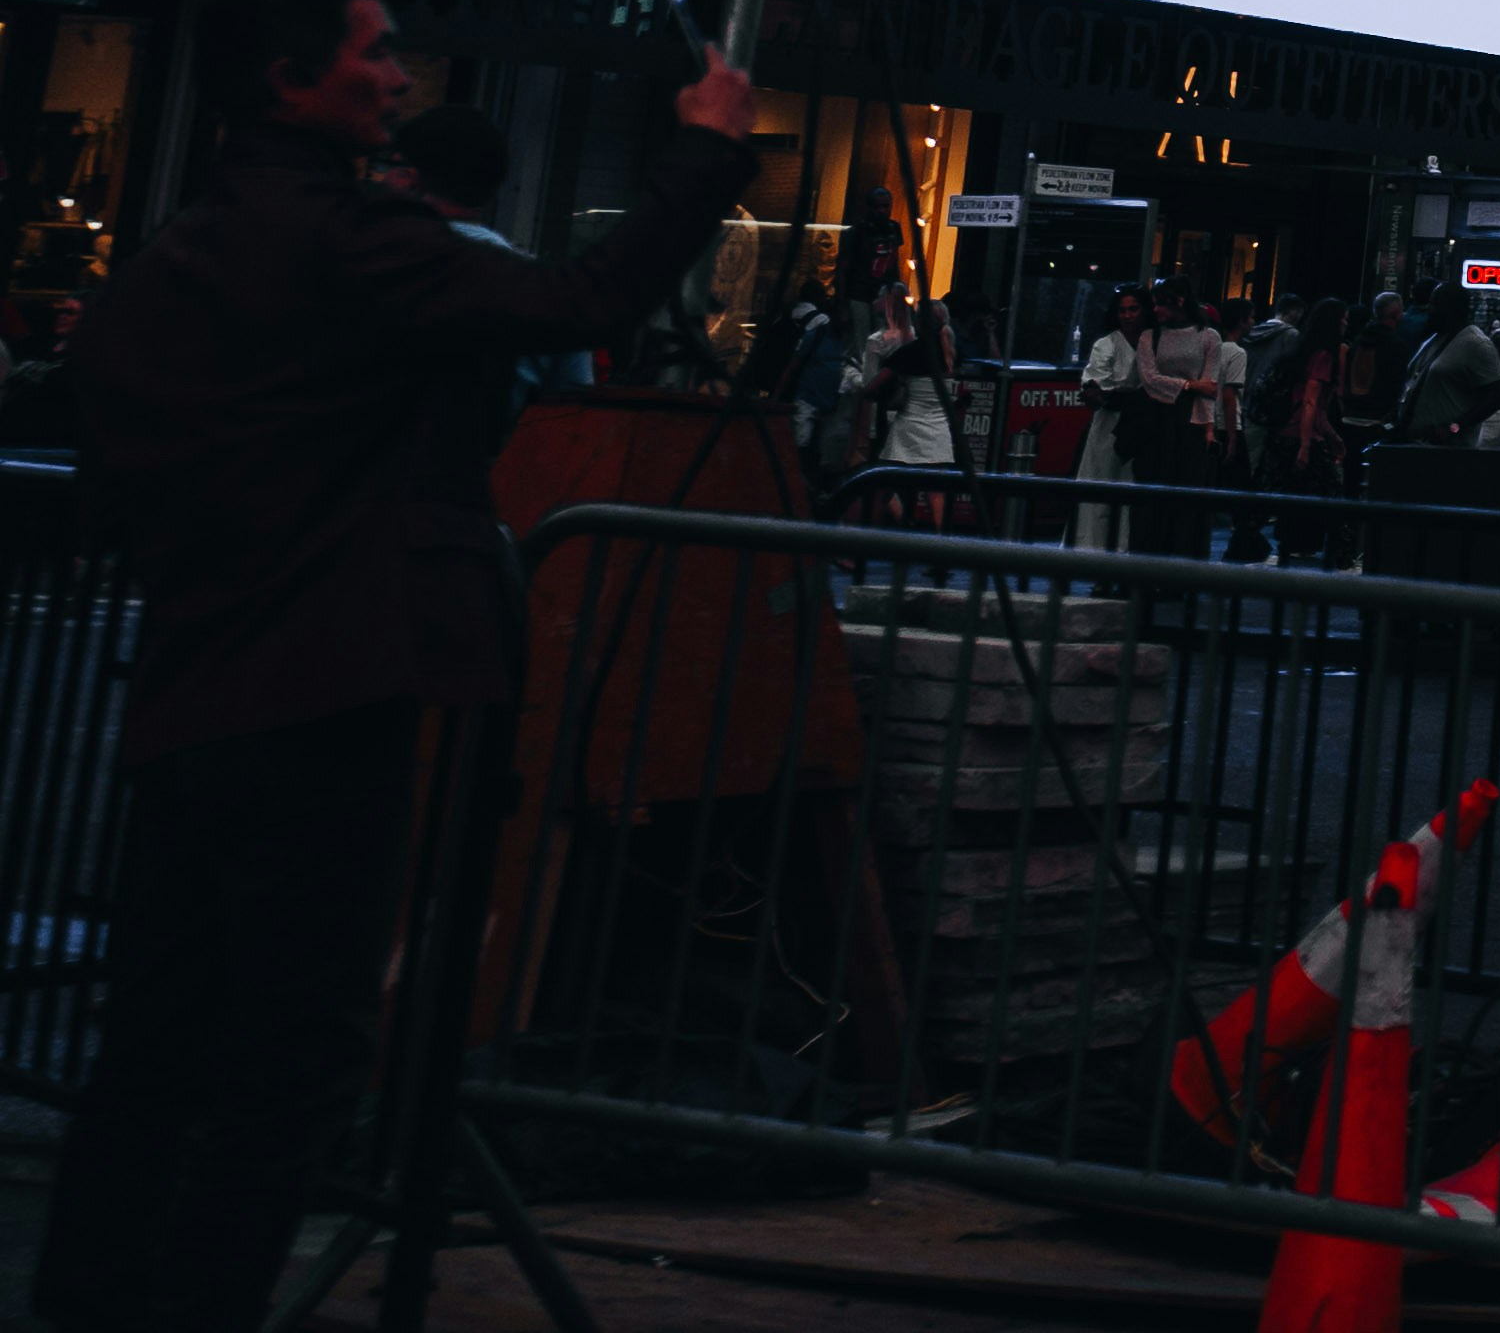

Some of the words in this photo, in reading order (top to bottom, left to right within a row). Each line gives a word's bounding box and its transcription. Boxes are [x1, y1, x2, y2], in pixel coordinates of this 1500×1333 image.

[1040, 169, 1078, 180] PEDESTRIAN
[1078, 171, 1095, 181] FLOW
[1096, 172, 1112, 182] ZONE
[1070, 183, 1087, 193] KEEP
[1087, 184, 1111, 194] MOVING
[952, 200, 985, 211] PEDESTRIAN
[985, 200, 1000, 211] FLOW
[1000, 200, 1015, 211] ZONE
[951, 213, 965, 223] KEEP
[965, 213, 987, 223] MOVING
[1391, 204, 1403, 278] Newsstand
[963, 414, 991, 436] BAD
